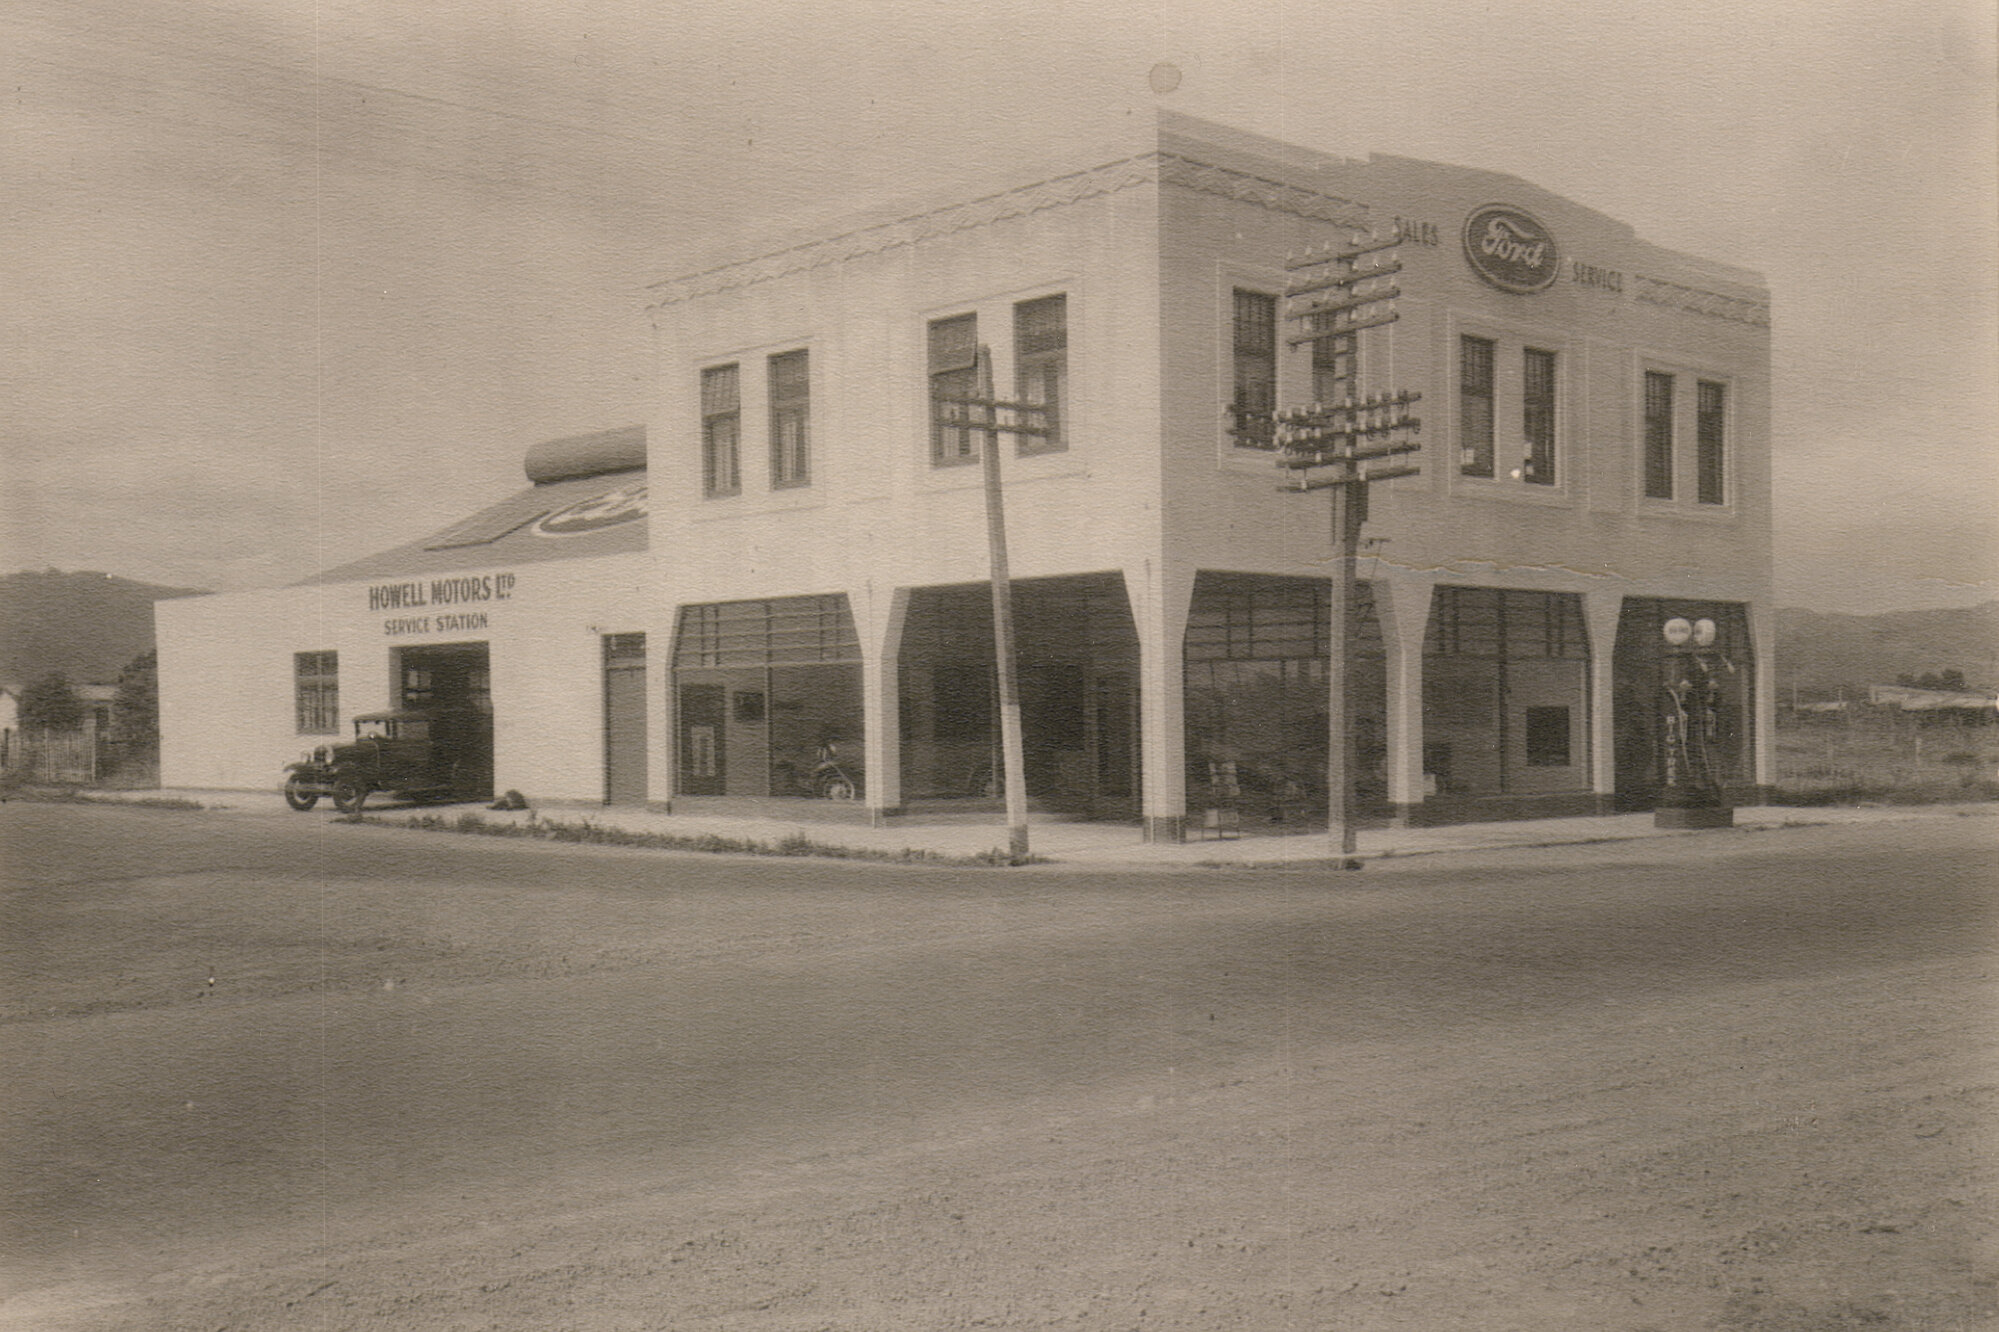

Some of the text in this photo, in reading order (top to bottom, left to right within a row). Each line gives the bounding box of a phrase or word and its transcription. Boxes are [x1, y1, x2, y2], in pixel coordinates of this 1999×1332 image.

[1393, 215, 1439, 247] SALES
[1481, 217, 1544, 268] Ford
[1572, 261, 1622, 292] SERVICE
[369, 582, 427, 610] HOWELL
[431, 576, 491, 604] MOTORS
[384, 612, 488, 635] SERVICE STATION
